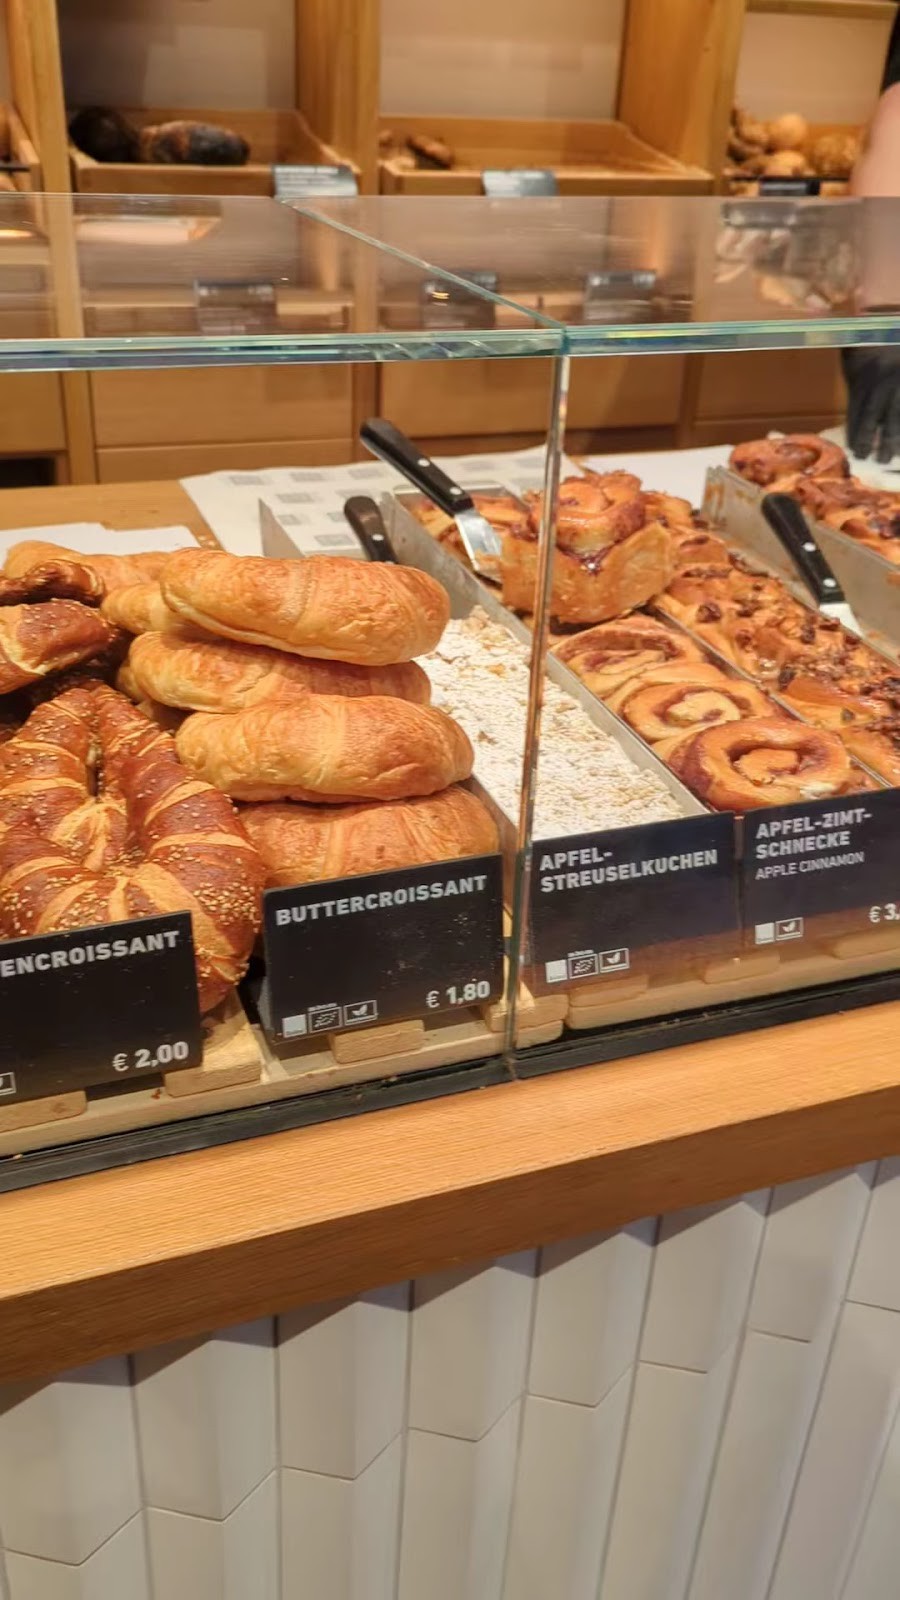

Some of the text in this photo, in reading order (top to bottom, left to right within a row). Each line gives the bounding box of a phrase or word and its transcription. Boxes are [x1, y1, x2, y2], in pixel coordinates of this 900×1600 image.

[756, 808, 872, 840] APFEL-ZIMT-
[540, 848, 612, 871] APFEL-
[756, 832, 850, 860] SCHNECKE
[540, 849, 718, 893] STREUSELKUCHEN
[755, 851, 865, 880] APPLE CINNAMON
[276, 875, 488, 926] BUTTERCROISSANT
[868, 905, 882, 923] €
[0, 930, 180, 978] ENCROISSANT
[426, 980, 491, 1009] € 1,80
[112, 1041, 189, 1072] € 2,00
